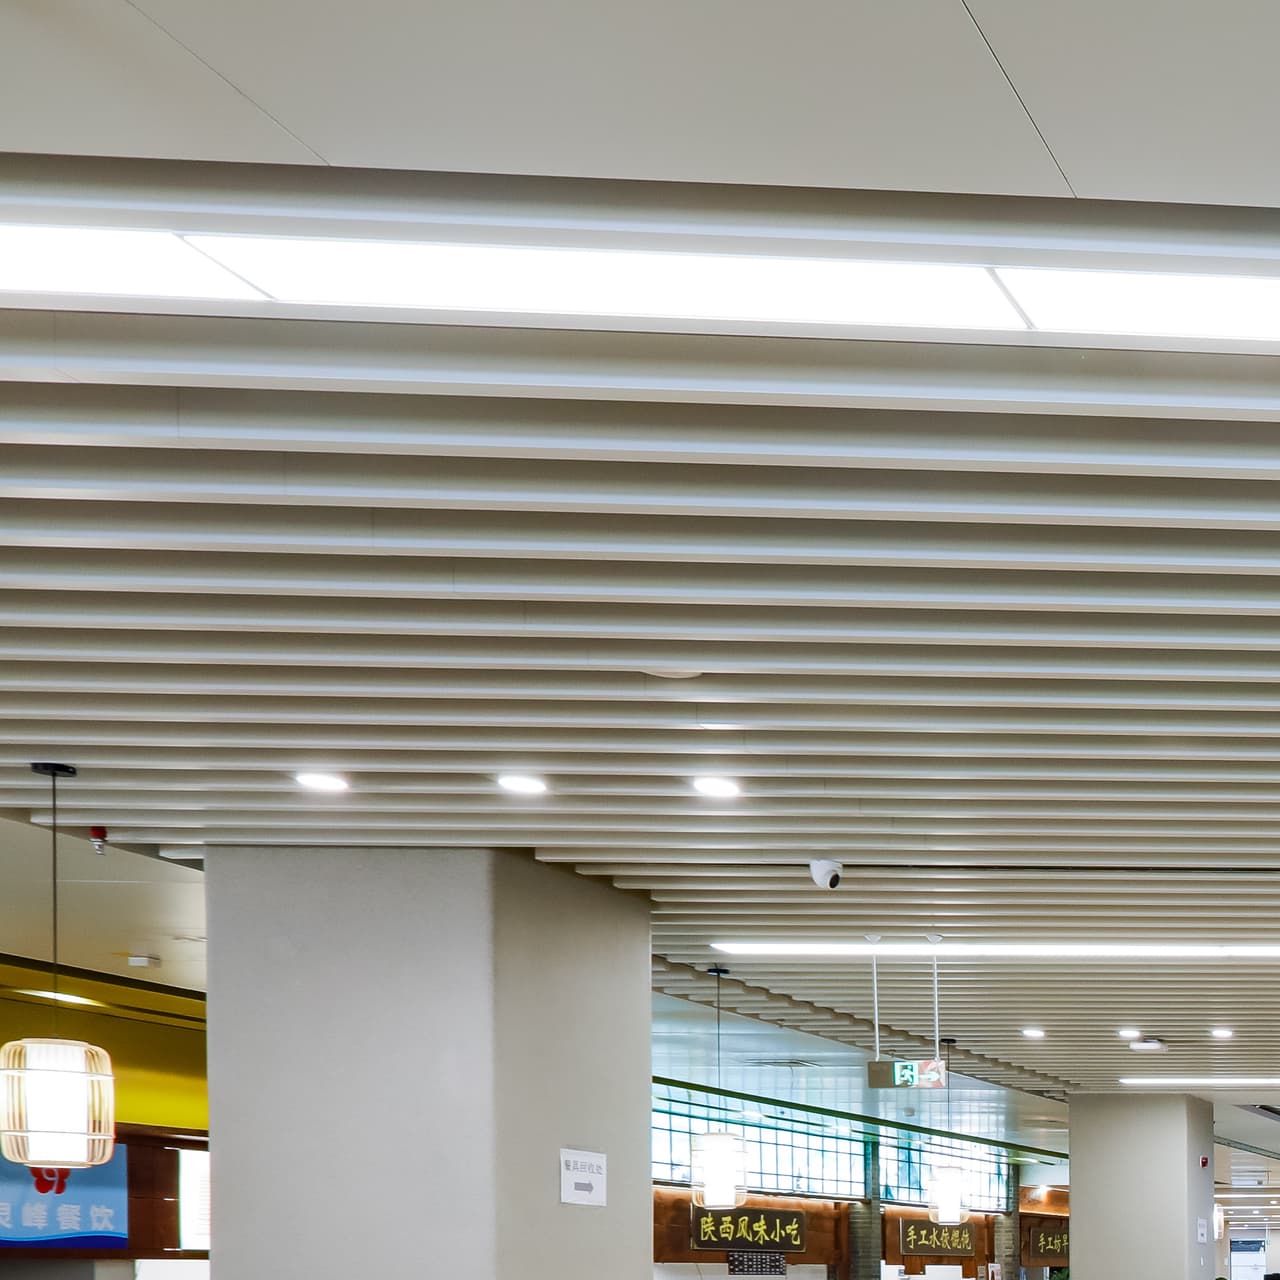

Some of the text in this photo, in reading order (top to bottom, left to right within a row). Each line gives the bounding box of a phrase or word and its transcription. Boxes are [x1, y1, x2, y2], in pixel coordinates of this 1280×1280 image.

[700, 1212, 801, 1246] 陕西风味小吃
[906, 1225, 972, 1250] 手工水饺馄饨
